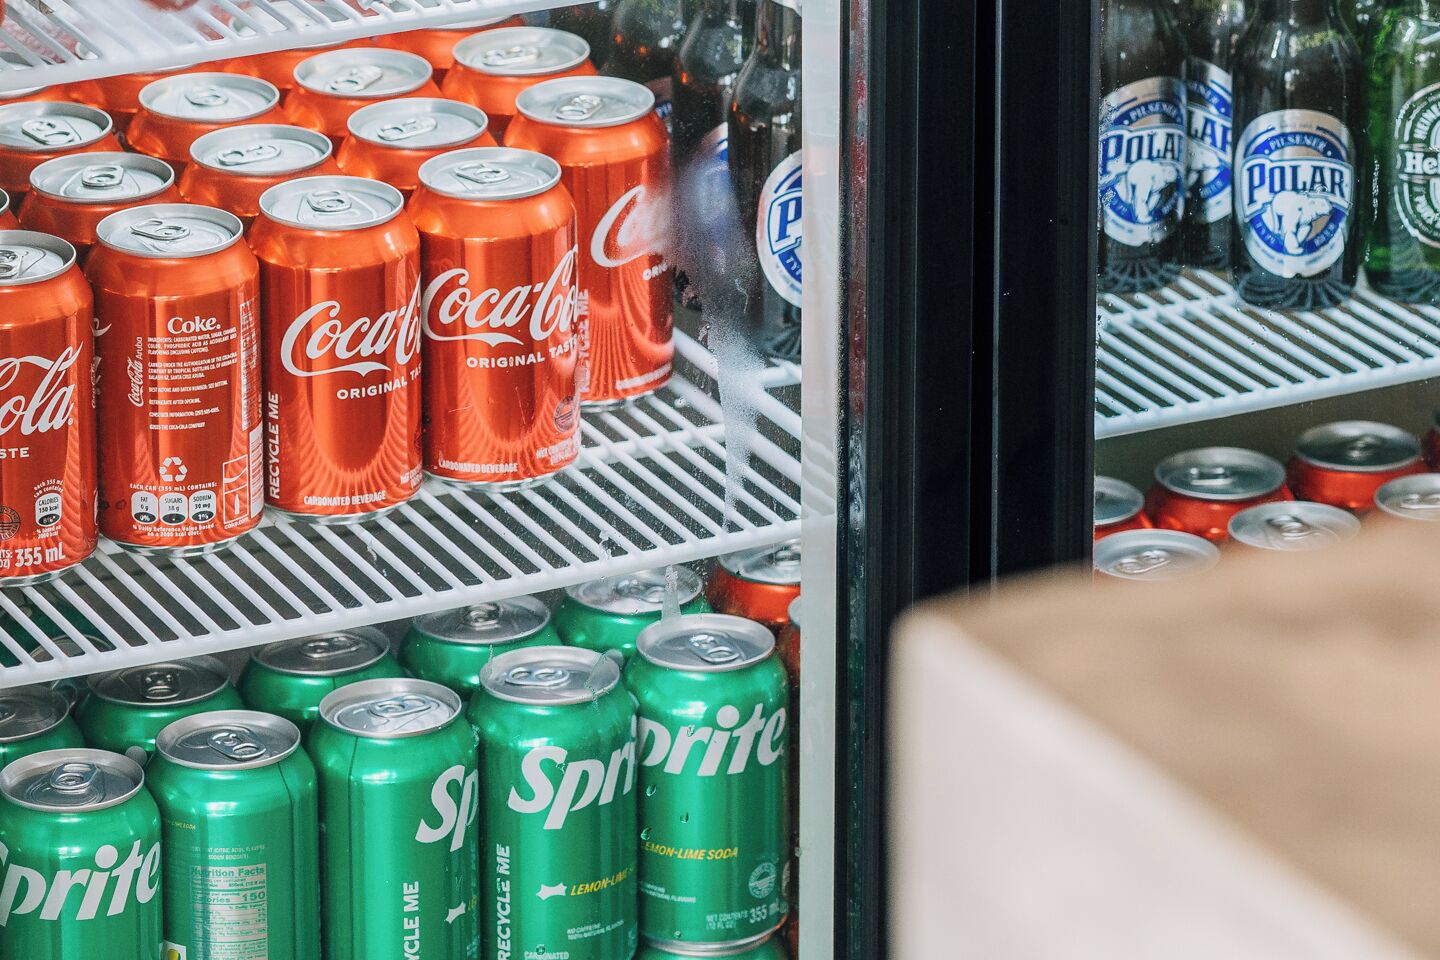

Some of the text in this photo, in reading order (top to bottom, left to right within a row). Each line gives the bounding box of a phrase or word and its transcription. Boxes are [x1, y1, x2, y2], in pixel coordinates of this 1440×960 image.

[1269, 133, 1326, 152] PILSENER
[1247, 163, 1345, 206] POLAR
[167, 315, 221, 334] Coke.
[466, 351, 545, 368] ORIGINAL
[336, 378, 407, 400] ORIGINAL
[268, 391, 280, 499] RECYCLE ME
[187, 482, 217, 490] CONTAINS:
[39, 496, 59, 506] CALORIES
[303, 489, 386, 506] CARBONATED BEVERAGE
[49, 504, 59, 512] kcal
[15, 546, 42, 568] 355
[45, 542, 65, 563] mL
[496, 844, 511, 875] ME
[707, 847, 738, 860] SODA
[238, 866, 265, 877] Facts
[242, 891, 265, 902] 150
[403, 881, 419, 913] ME
[749, 904, 768, 923] 355
